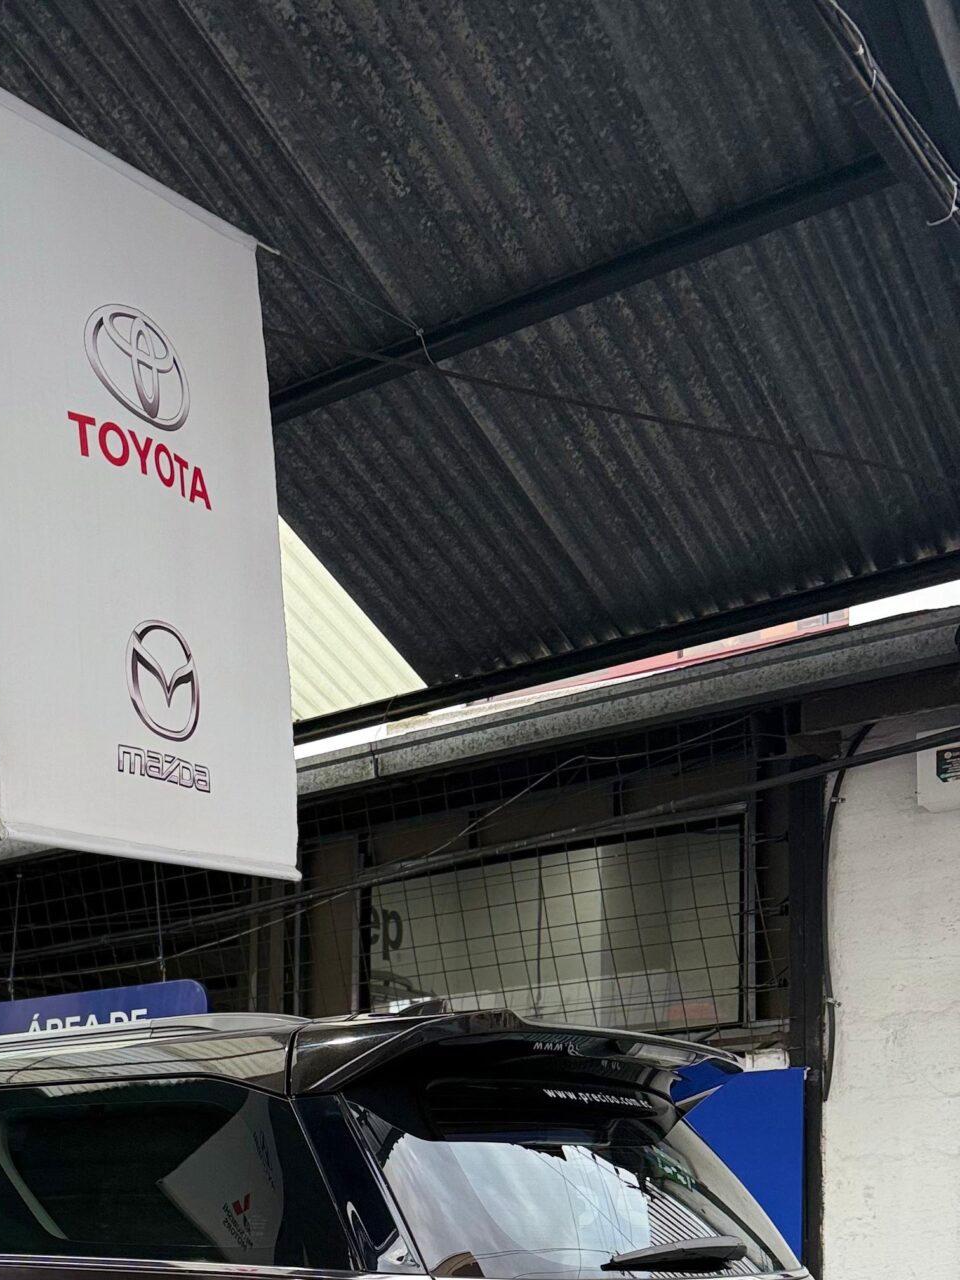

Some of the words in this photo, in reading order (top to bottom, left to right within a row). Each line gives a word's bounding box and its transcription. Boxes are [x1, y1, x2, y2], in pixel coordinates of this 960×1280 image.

[67, 411, 212, 511] TOYOTA
[118, 744, 211, 793] mazda
[542, 1088, 653, 1109] www.preciso.com.ec
